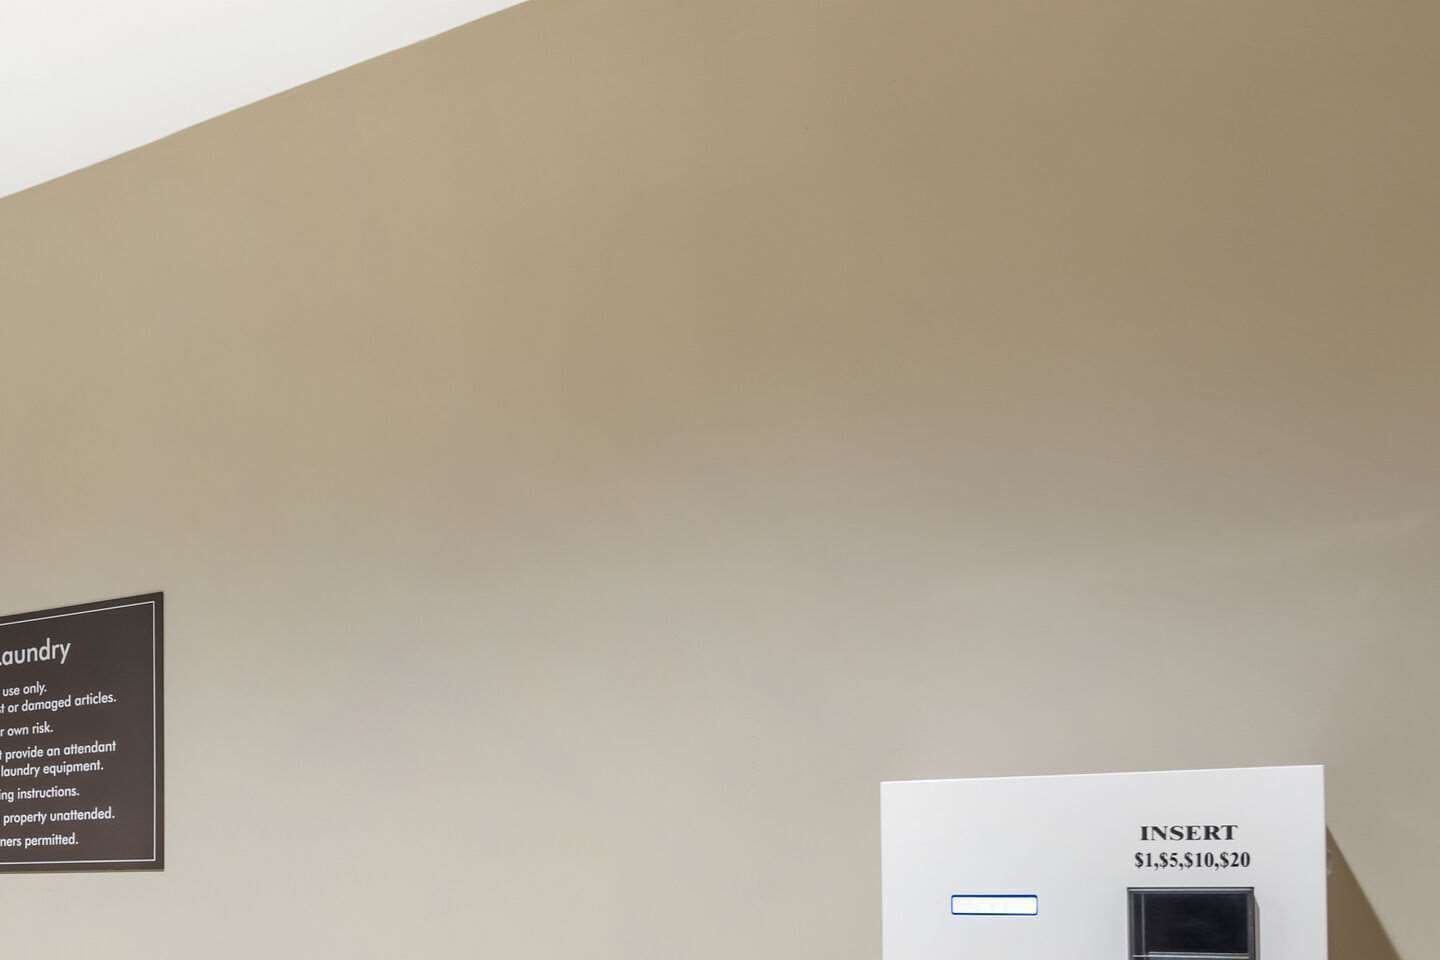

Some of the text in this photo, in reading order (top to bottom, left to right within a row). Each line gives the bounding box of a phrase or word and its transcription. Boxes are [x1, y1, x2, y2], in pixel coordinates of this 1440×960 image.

[3, 688, 19, 696] use
[23, 681, 47, 696] only.
[8, 704, 19, 712] or
[22, 695, 71, 711] damaged
[75, 692, 116, 706] articles.
[7, 726, 29, 736] own
[32, 721, 53, 734] risk.
[5, 746, 44, 762] provide
[47, 748, 60, 756] an
[64, 740, 116, 755] attendant
[1, 764, 40, 777] laundry
[43, 760, 103, 776] equipment.
[17, 785, 79, 799] instructions.
[3, 812, 46, 826] property
[50, 806, 115, 821] unattended.
[25, 832, 78, 848] permitted.
[1140, 825, 1238, 841] INSERT
[1134, 851, 1251, 869] $1,$5,$10,$20
